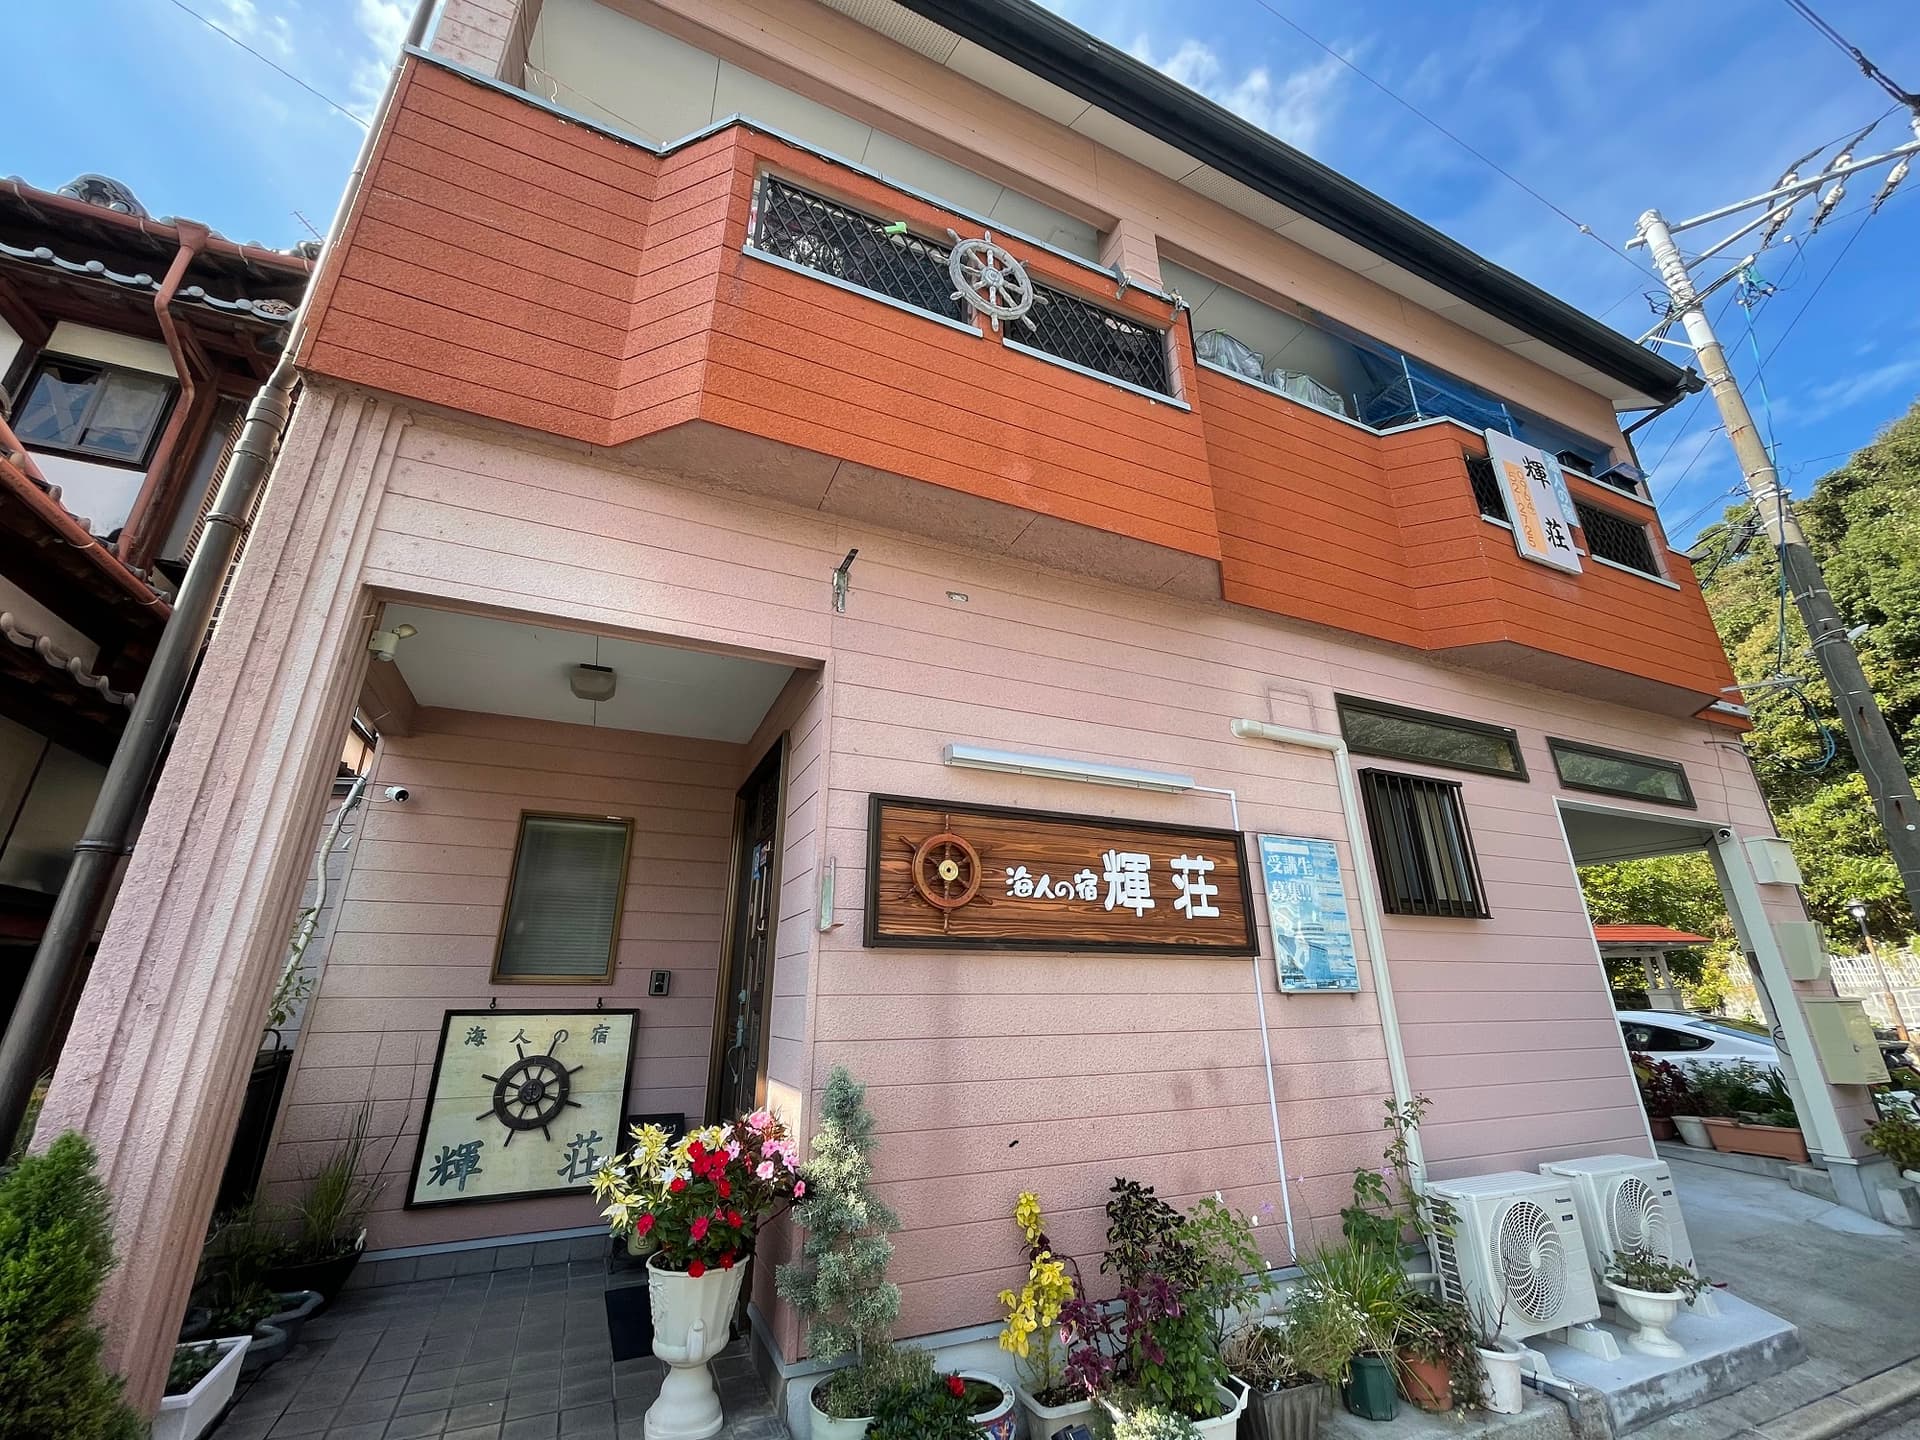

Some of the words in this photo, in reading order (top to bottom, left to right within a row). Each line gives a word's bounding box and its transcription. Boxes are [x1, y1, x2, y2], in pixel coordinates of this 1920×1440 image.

[1004, 865, 1099, 902] 海人の宿
[1101, 848, 1221, 920] 輝荘
[464, 1023, 612, 1048] 海人の宿
[426, 1129, 604, 1192] 輝荘
